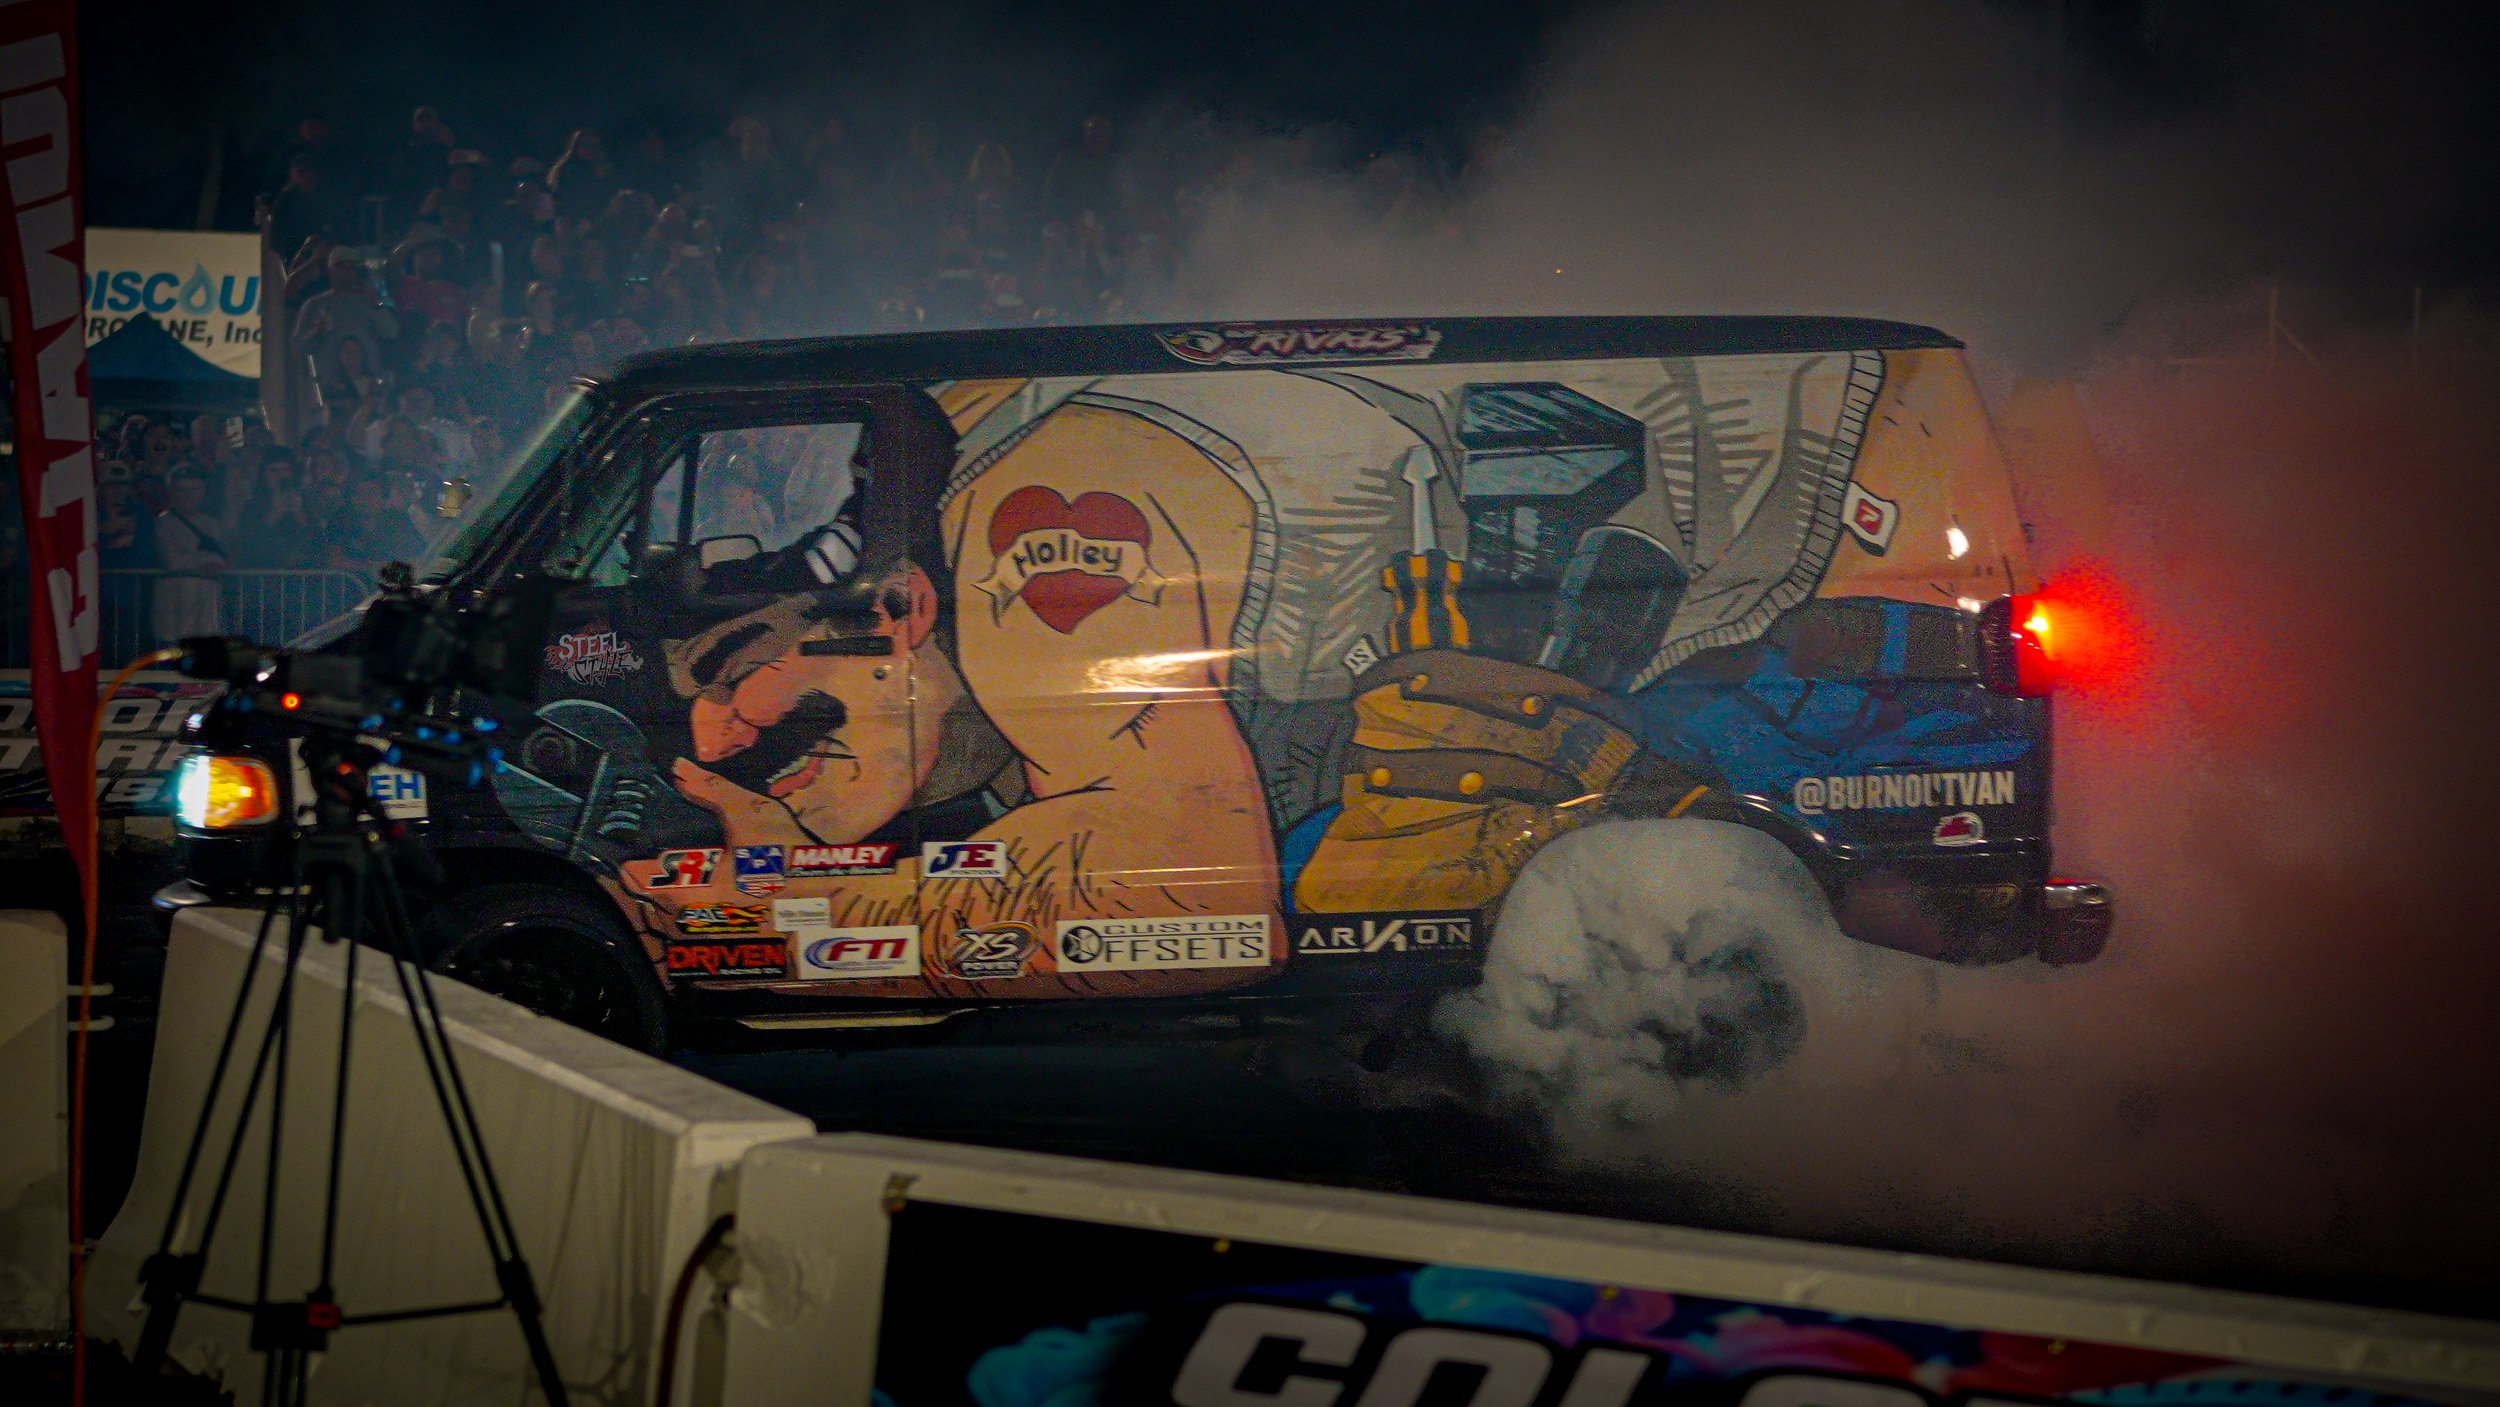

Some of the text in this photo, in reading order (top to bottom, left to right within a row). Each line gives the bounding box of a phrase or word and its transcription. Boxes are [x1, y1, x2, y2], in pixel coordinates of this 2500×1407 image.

[1012, 533, 1122, 578] Holley
[559, 631, 627, 661] STEEL
[1794, 771, 2015, 815] @BURNOUTVAN
[792, 845, 890, 866] MANLEY
[929, 844, 996, 873] JE
[1104, 921, 1263, 935] CUSTOM
[666, 943, 788, 976] DRIVEN
[828, 938, 908, 961] FTI
[959, 931, 1021, 960] XS
